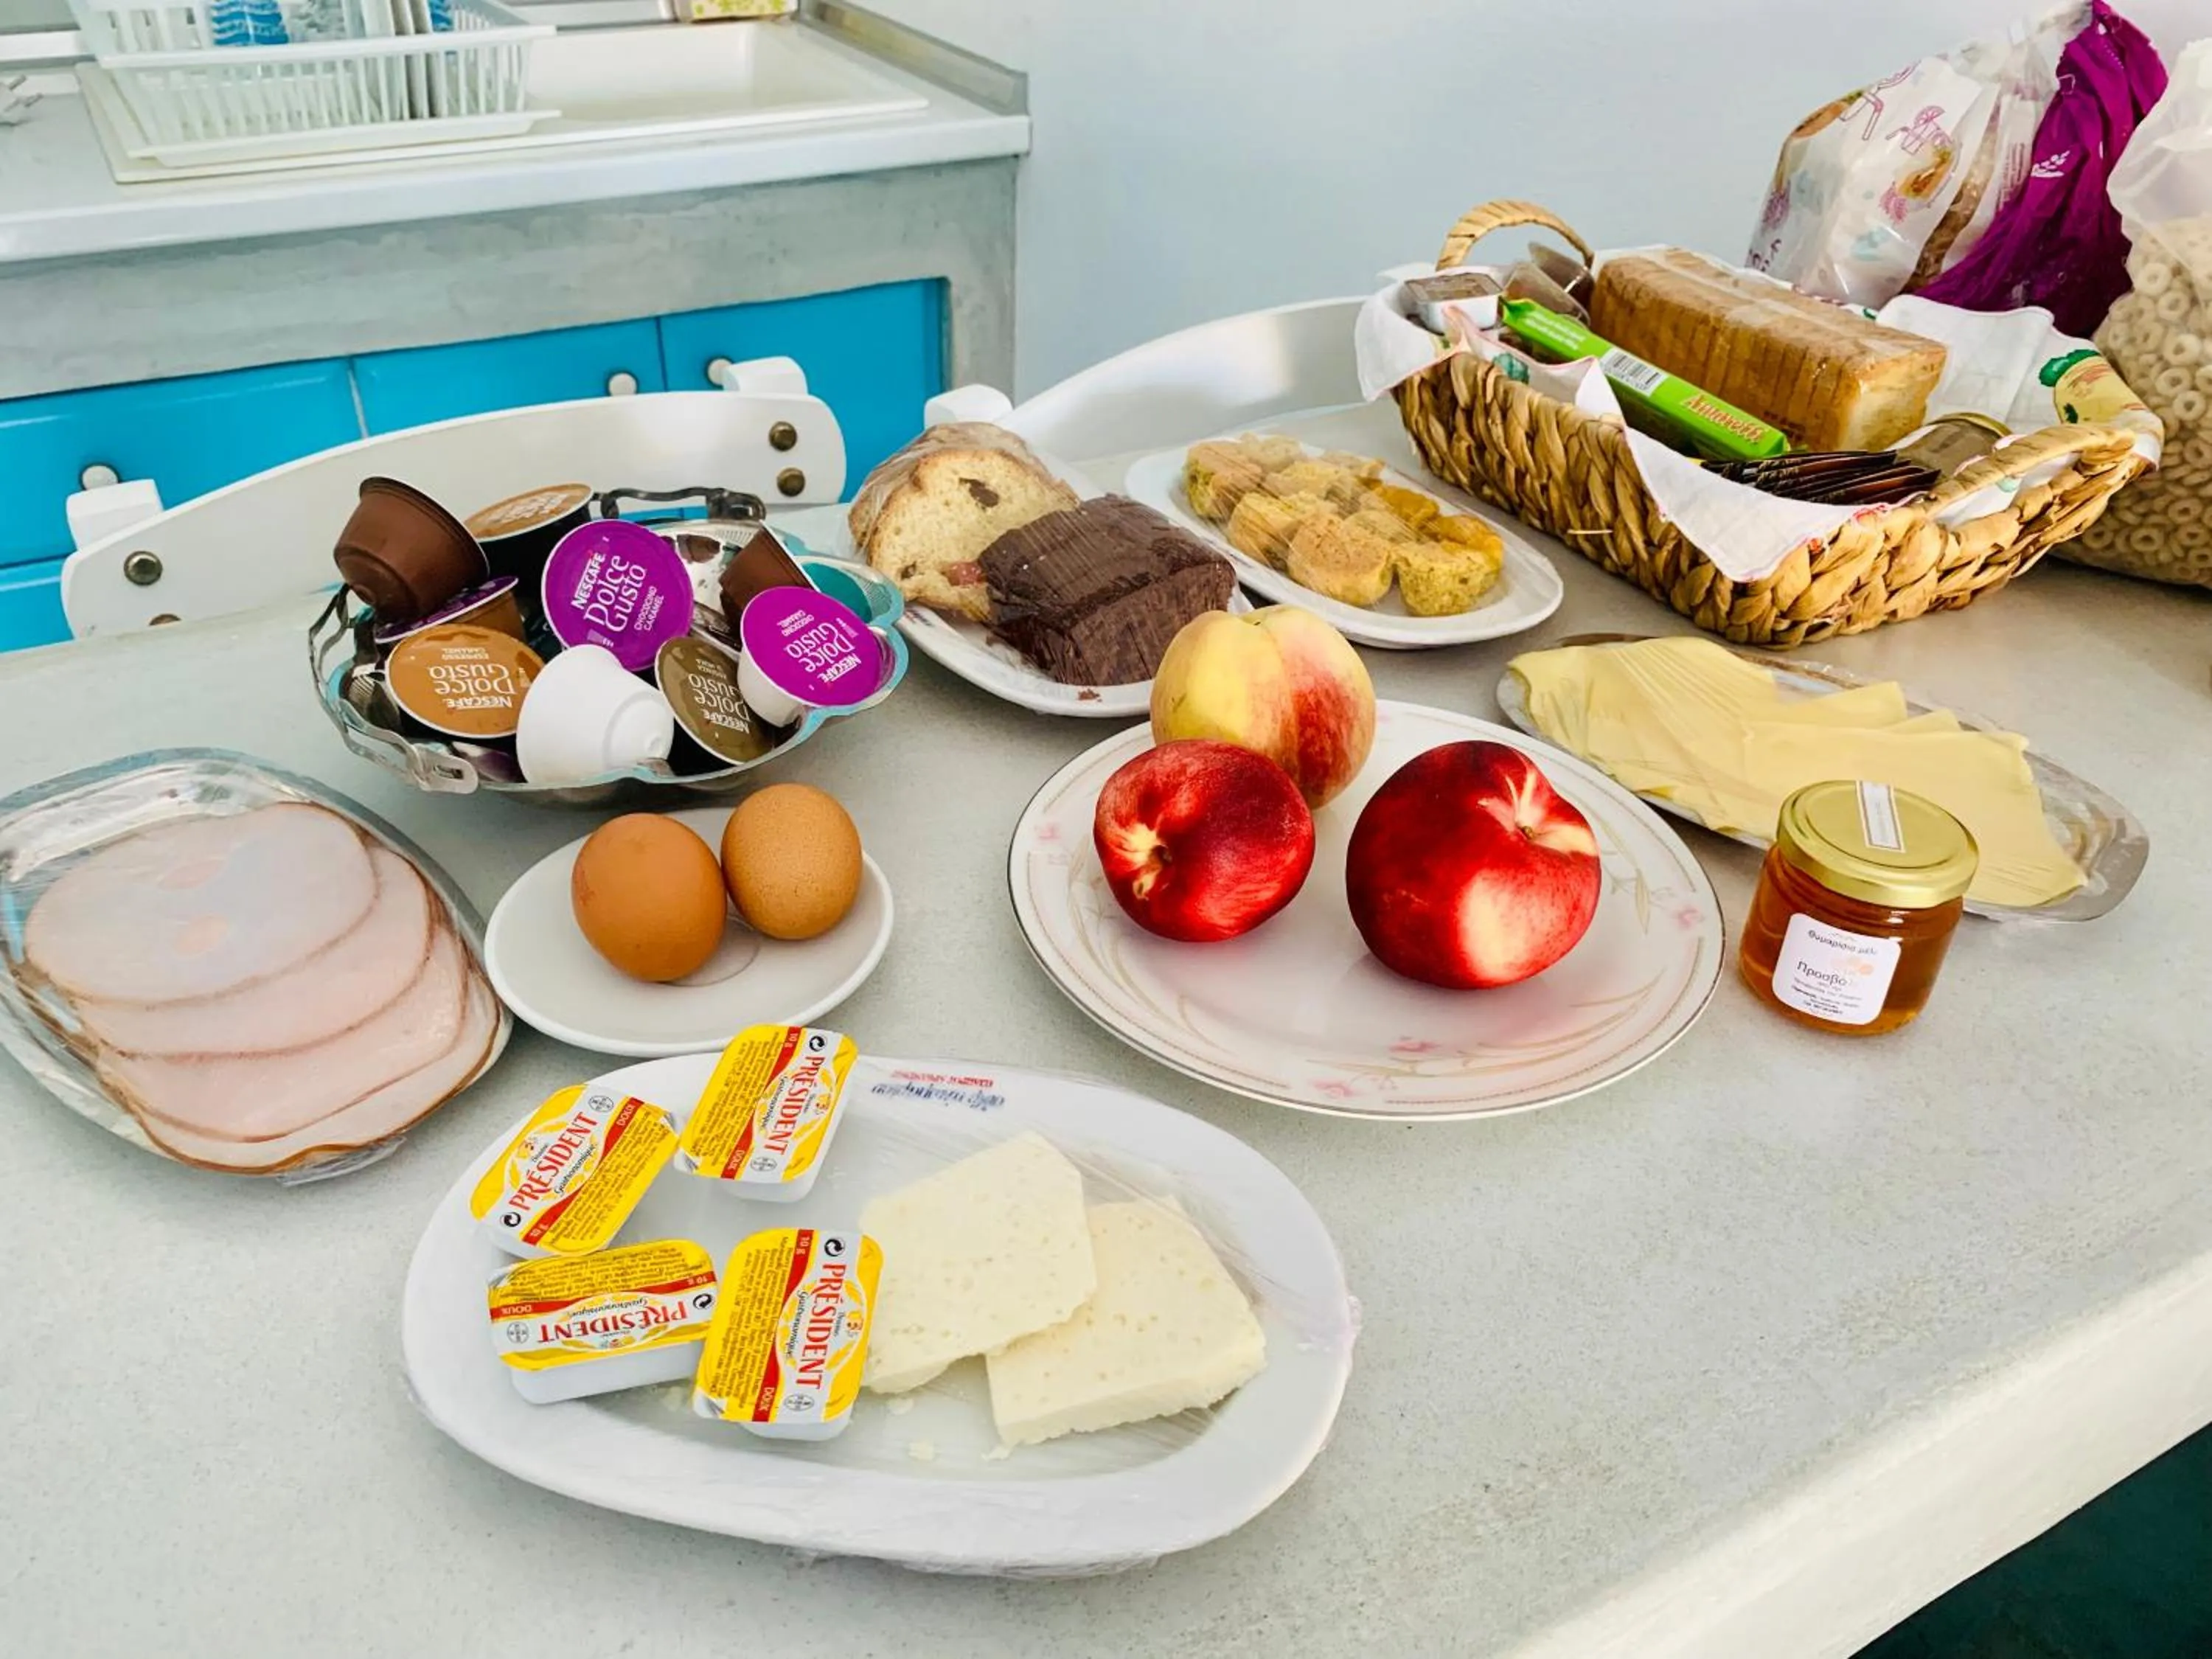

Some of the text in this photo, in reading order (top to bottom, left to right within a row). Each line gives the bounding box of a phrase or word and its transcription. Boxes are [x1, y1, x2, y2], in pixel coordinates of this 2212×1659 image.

[583, 554, 630, 626] Dolce
[605, 564, 647, 632] Gusto
[783, 622, 839, 658] Gusto
[798, 633, 856, 672] Dolce
[428, 664, 510, 681] Gusto
[432, 678, 517, 695] Dolce
[693, 688, 751, 722] Dolce
[763, 1055, 827, 1155] PRÉSIDENT
[509, 1111, 598, 1211] PRÉSIDENT
[799, 1237, 810, 1247] 10
[538, 1301, 688, 1343] PRÉSIDENT
[784, 1290, 810, 1357] Gastronomique
[796, 1264, 847, 1390] PRÉSIDENT
[758, 1386, 775, 1411] DOUX
